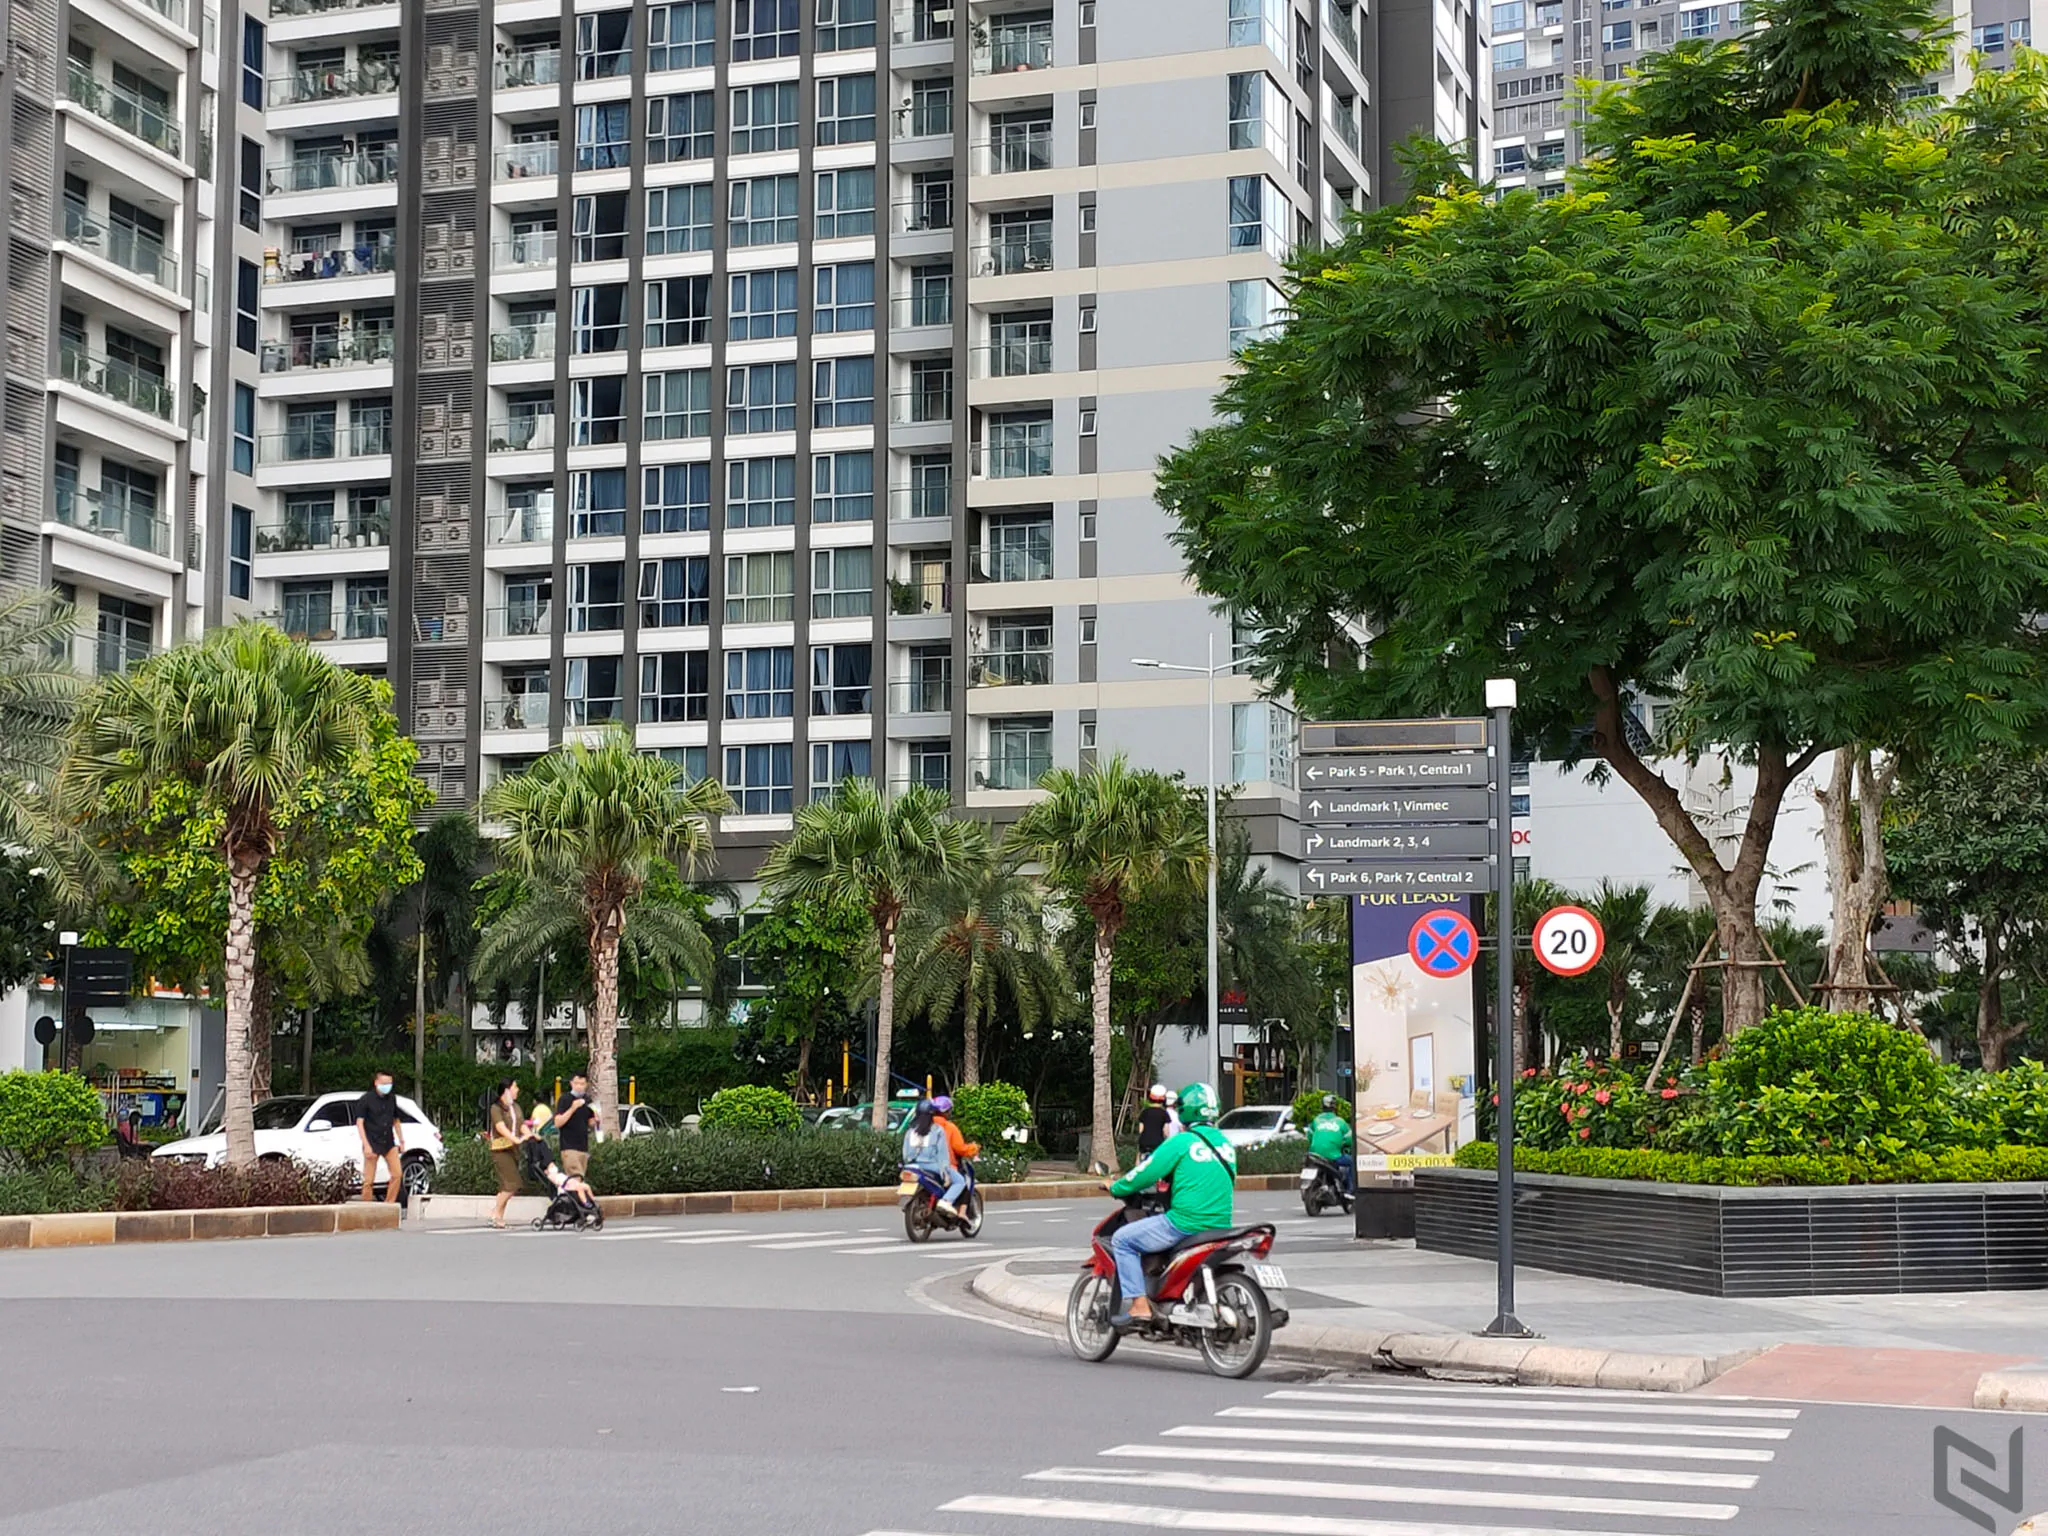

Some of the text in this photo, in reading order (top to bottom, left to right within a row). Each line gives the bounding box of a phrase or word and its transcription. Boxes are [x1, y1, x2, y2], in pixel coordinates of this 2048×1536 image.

[1329, 766, 1356, 778] Park
[1359, 767, 1367, 777] 5
[1378, 766, 1405, 776] Park
[1408, 766, 1417, 778] 1,
[1419, 764, 1463, 776] Central
[1466, 763, 1472, 775] 1
[1329, 800, 1449, 813] Landmark 1, Vinmec
[1329, 837, 1430, 850] Landmark 2, 3, 4
[1330, 872, 1473, 885] Park 6, Park 7, Central 2
[1551, 929, 1587, 955] 20
